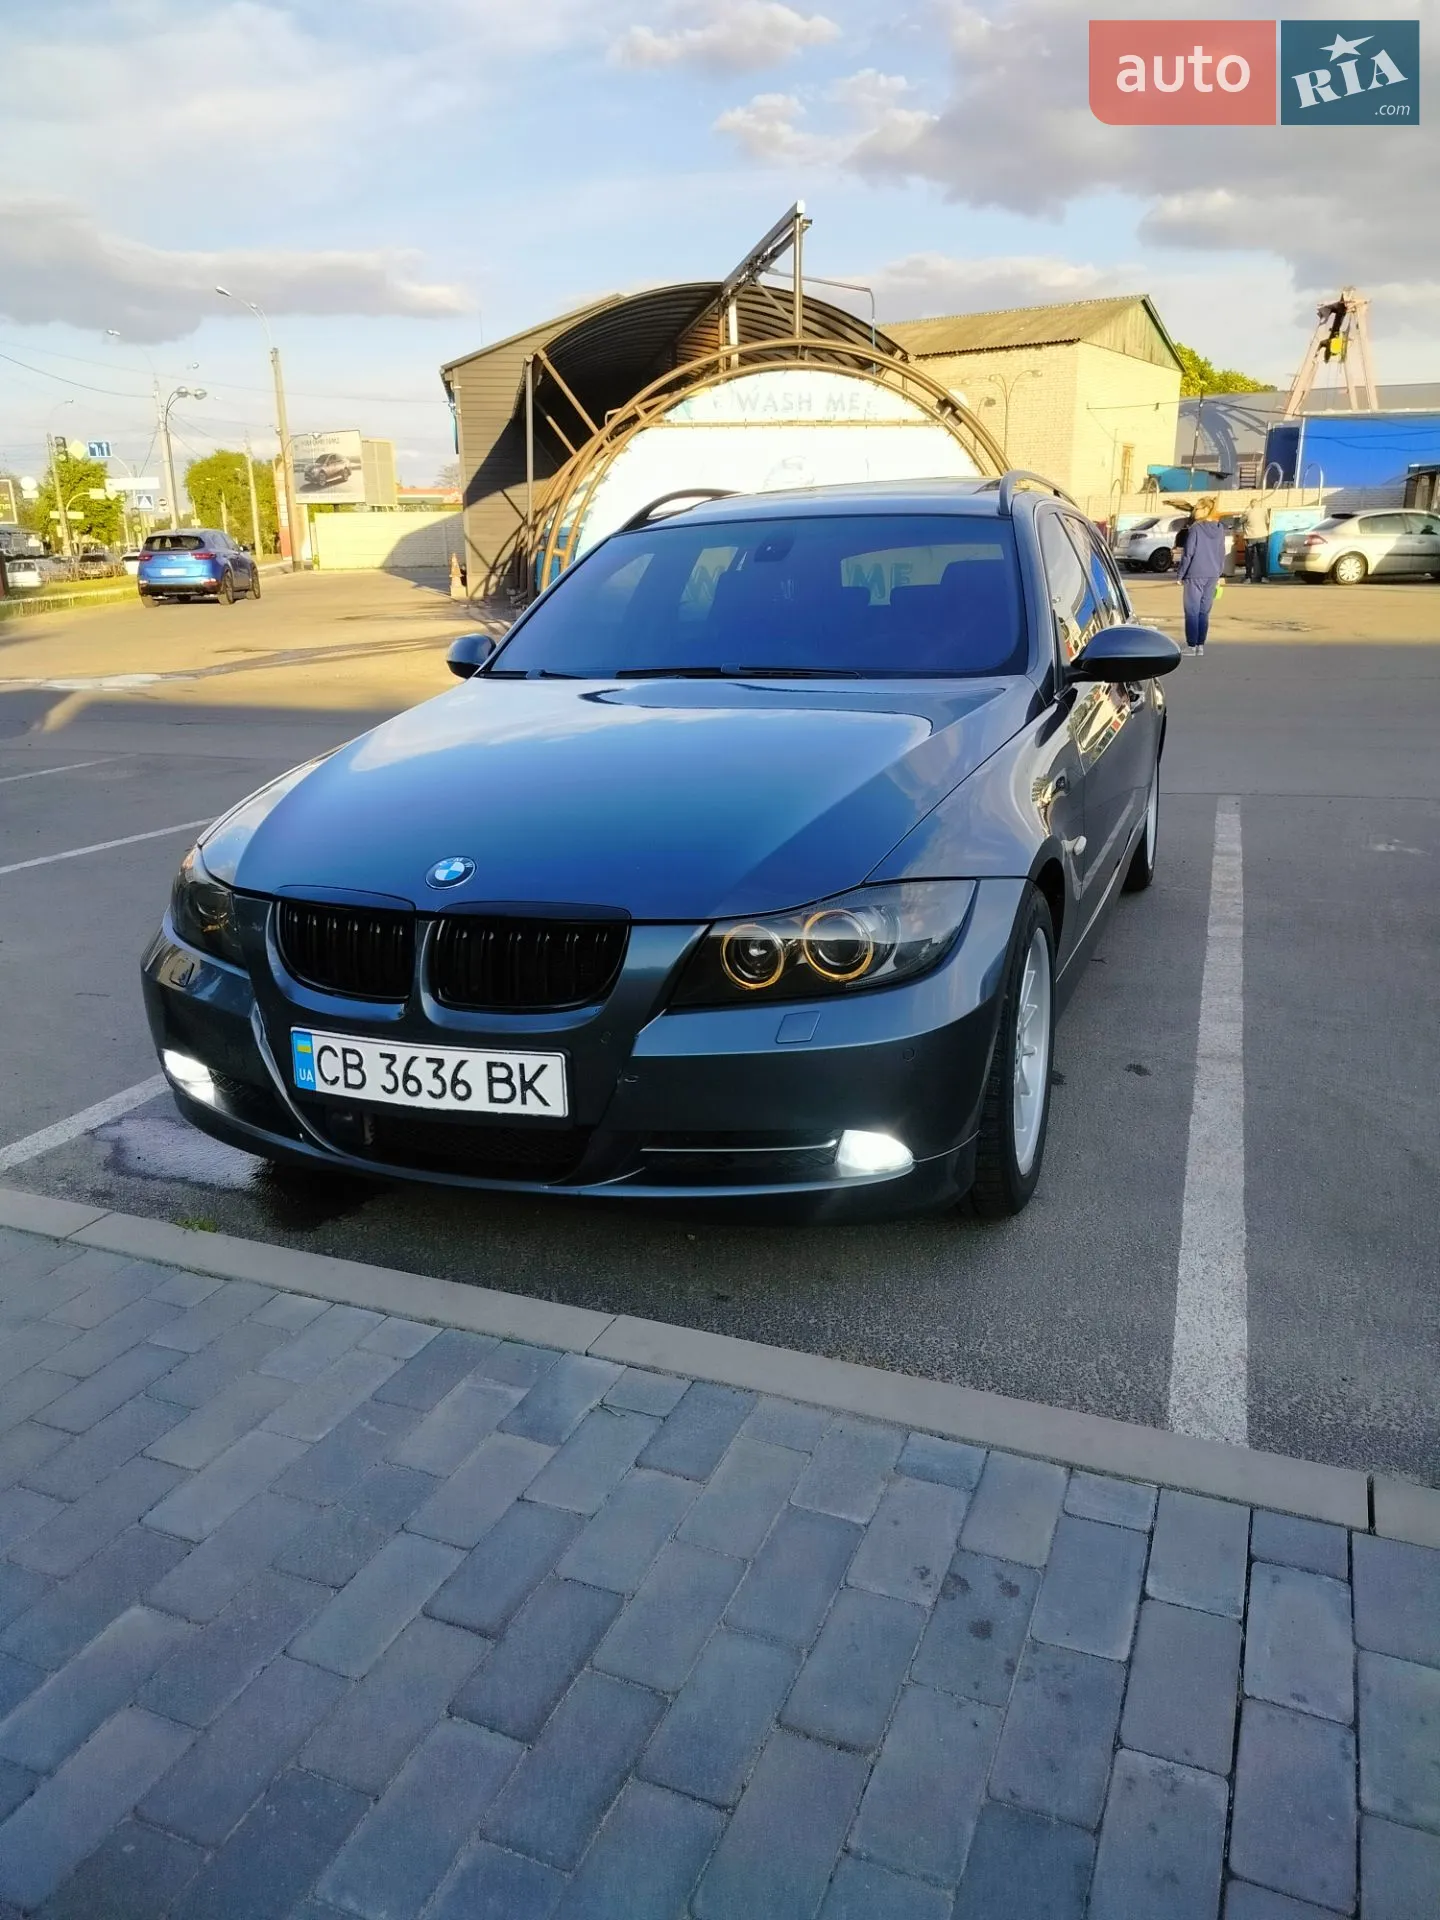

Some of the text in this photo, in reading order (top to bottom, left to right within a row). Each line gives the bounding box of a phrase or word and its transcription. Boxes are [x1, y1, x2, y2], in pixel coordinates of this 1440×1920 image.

[736, 391, 812, 412] WASH
[299, 1067, 314, 1083] UA
[317, 1044, 551, 1107] CB 3636 BK
